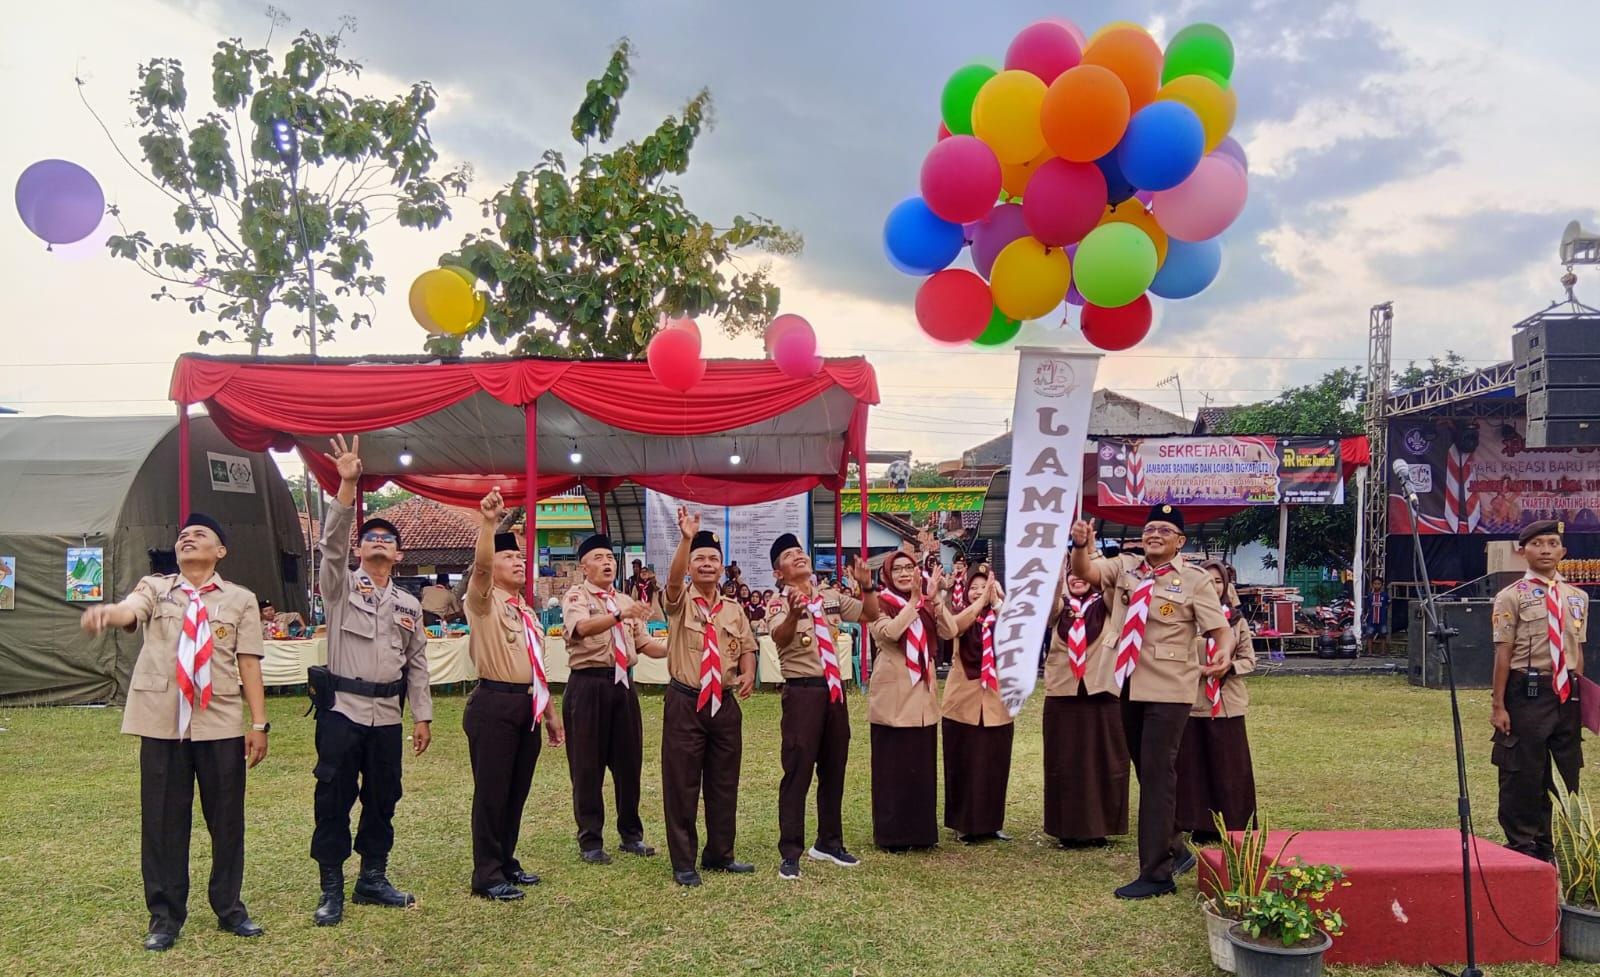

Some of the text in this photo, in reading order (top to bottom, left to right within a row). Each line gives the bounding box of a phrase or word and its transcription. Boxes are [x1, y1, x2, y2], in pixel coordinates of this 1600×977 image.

[1159, 444, 1248, 458] SEKRETARIAT
[1146, 463, 1172, 474] JAMBORE
[1173, 463, 1199, 474] RANTING
[1200, 463, 1212, 474] DAN
[1213, 463, 1234, 474] LOMBA
[1549, 461, 1583, 473] BARU
[394, 604, 417, 617] POLRI
